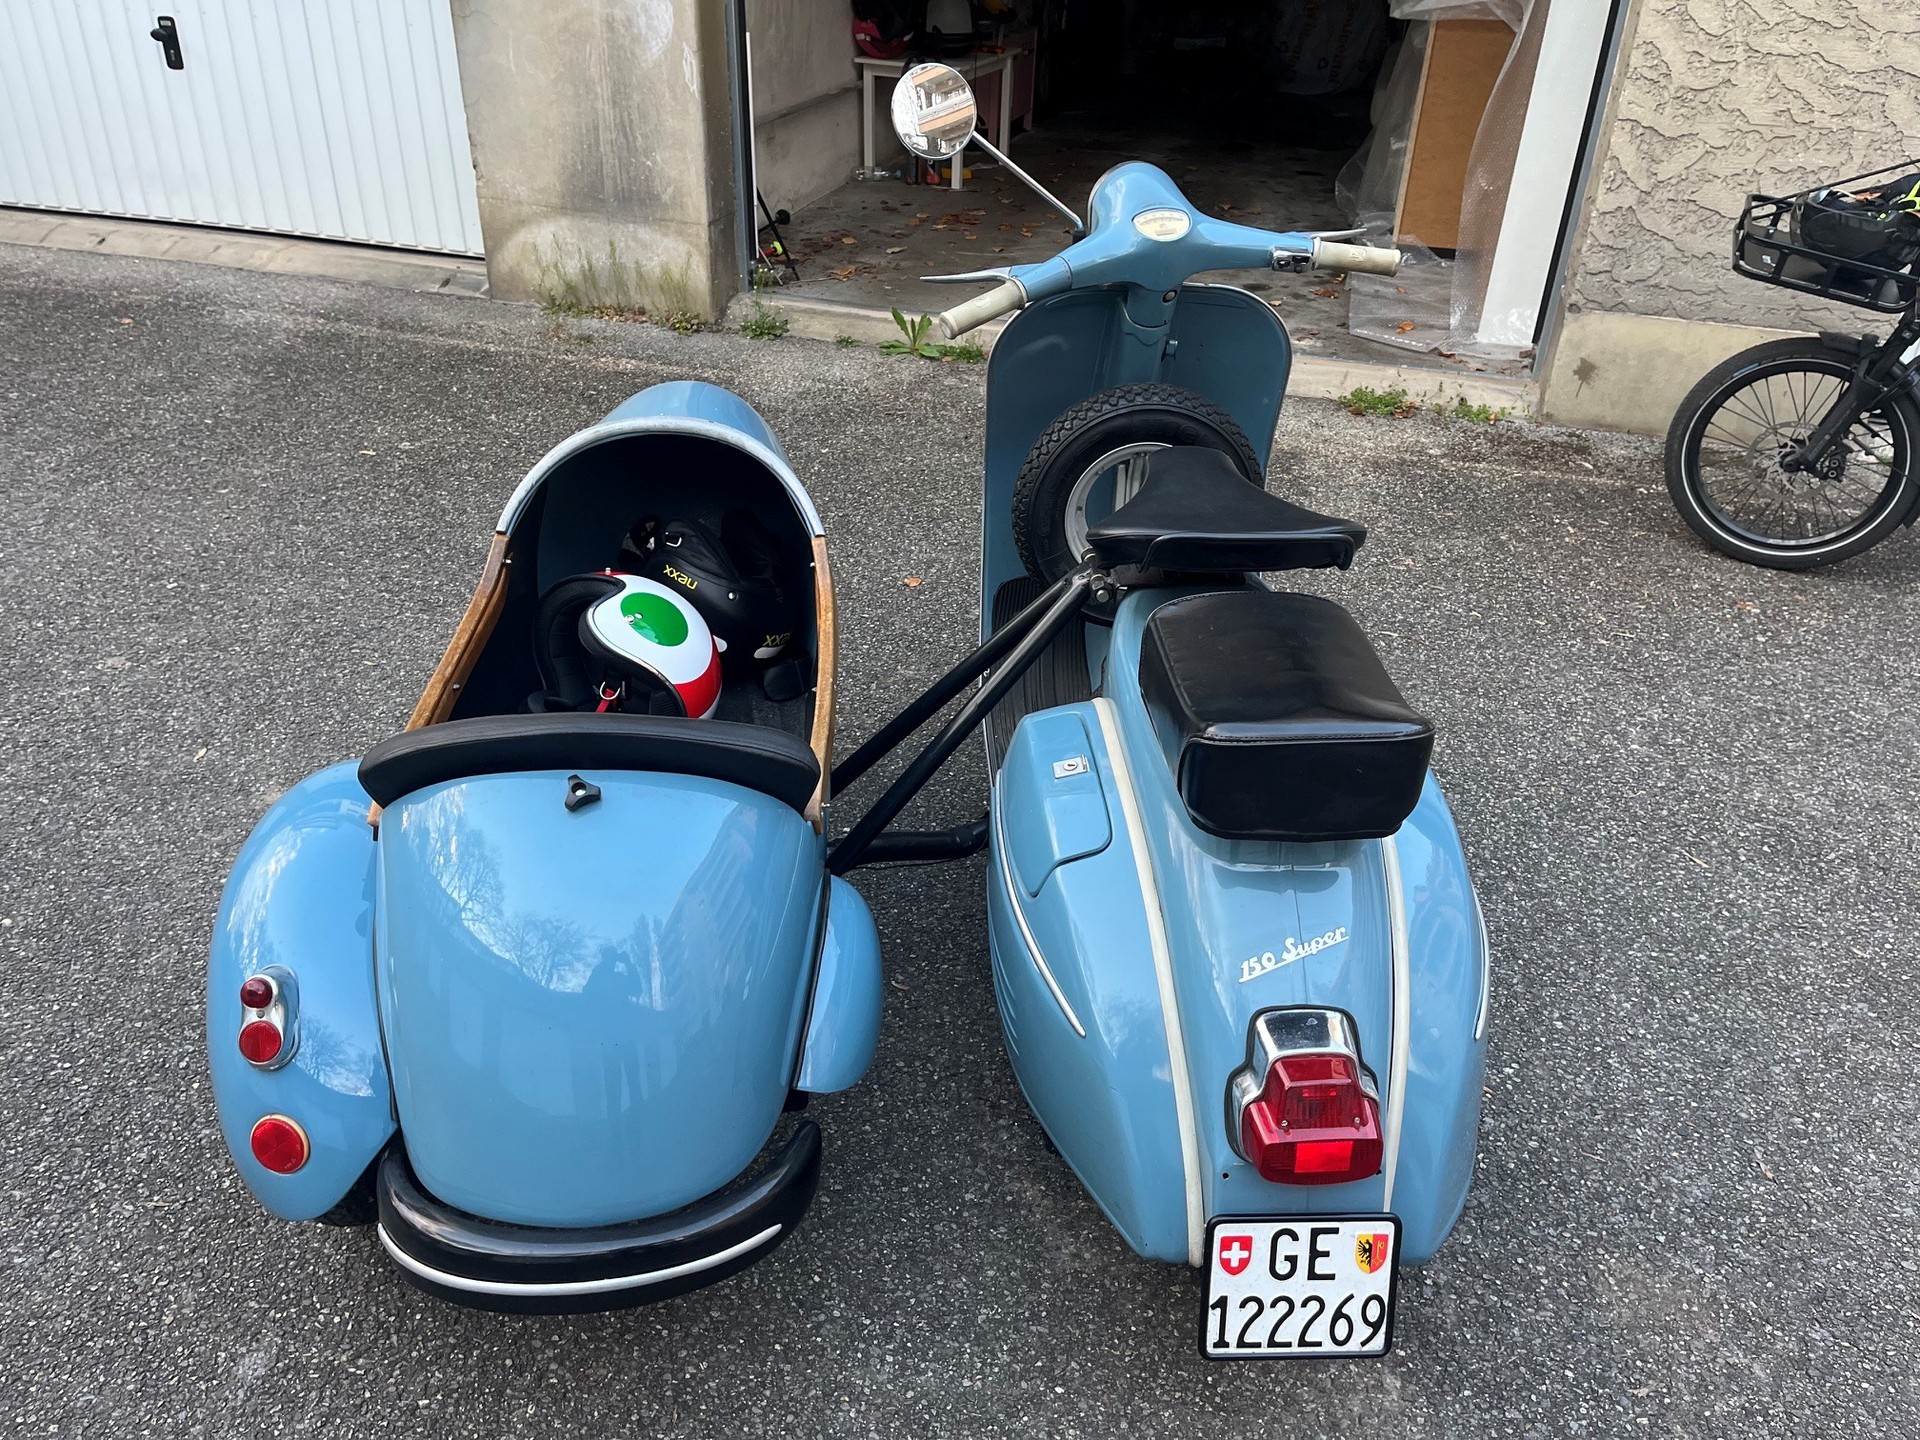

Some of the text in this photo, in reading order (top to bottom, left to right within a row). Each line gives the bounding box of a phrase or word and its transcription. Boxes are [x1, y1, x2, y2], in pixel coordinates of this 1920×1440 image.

[663, 564, 698, 590] nexx
[1240, 926, 1347, 979] 150 Super
[1268, 1227, 1340, 1281] GE
[1209, 1293, 1386, 1349] 122269
